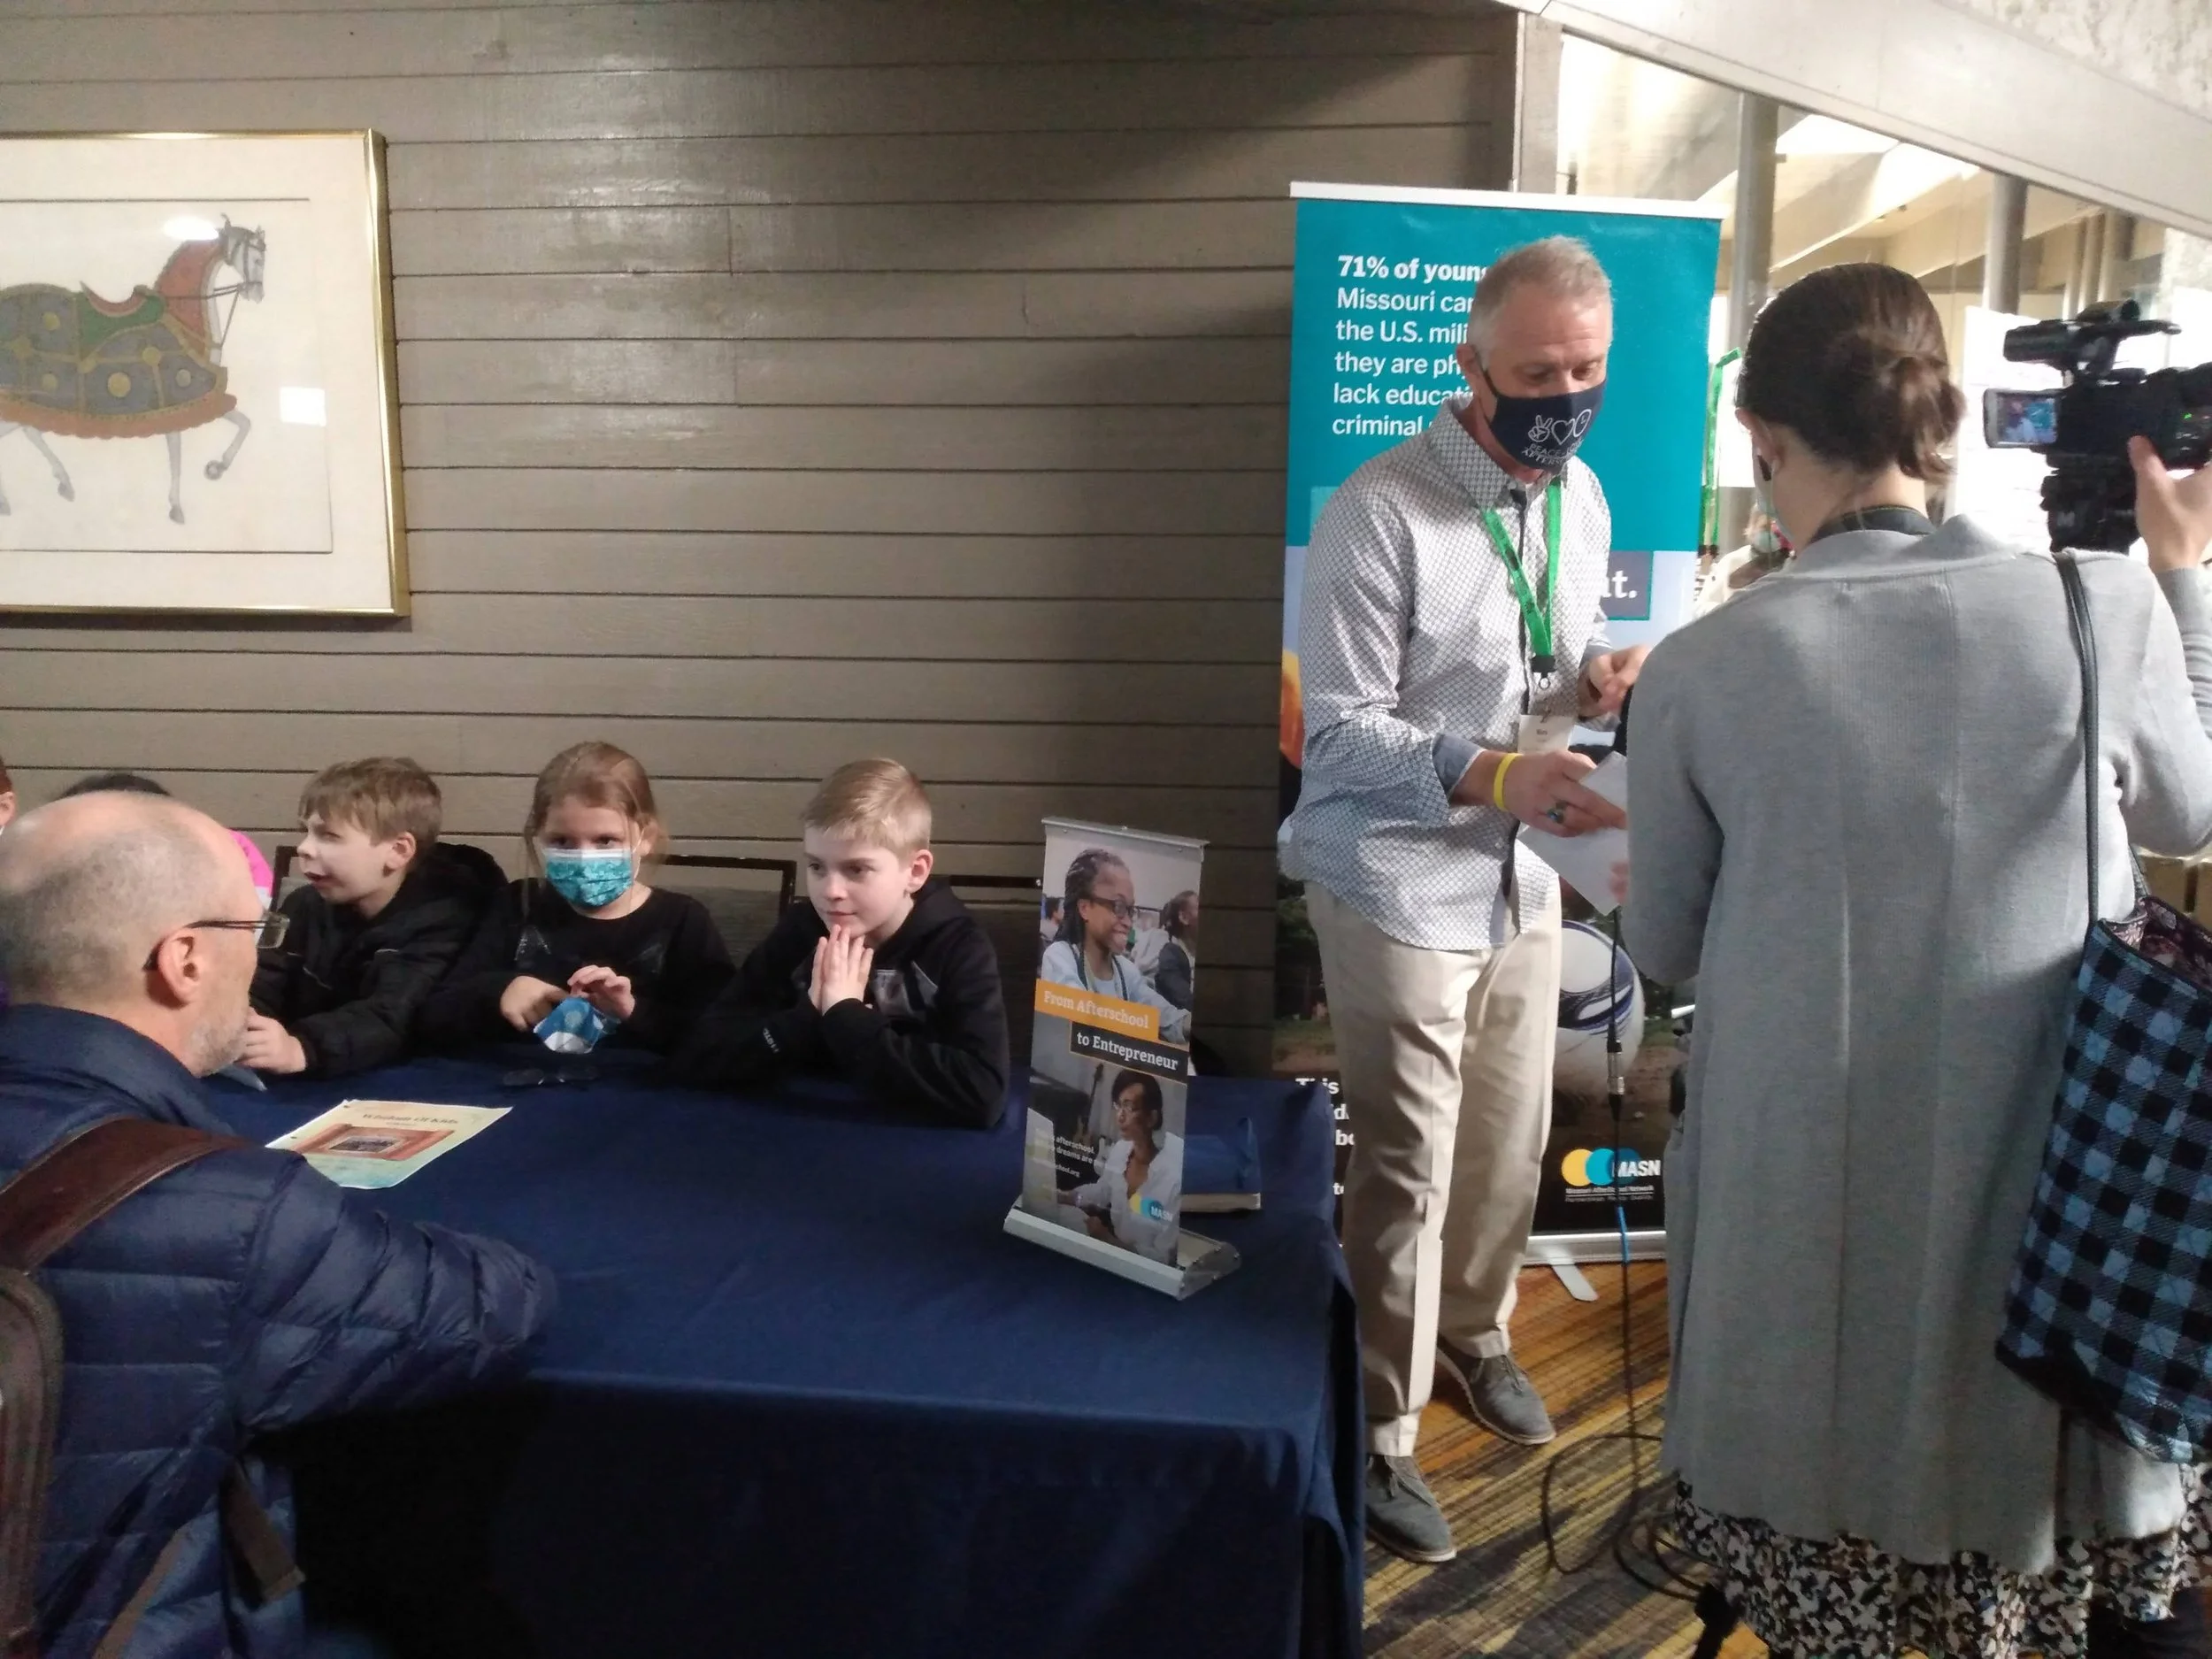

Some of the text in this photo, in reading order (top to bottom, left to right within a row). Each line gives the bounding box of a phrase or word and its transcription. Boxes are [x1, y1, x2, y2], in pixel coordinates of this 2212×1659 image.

[1338, 255, 1390, 279] 71%
[1394, 257, 1420, 280] of
[1337, 287, 1436, 311] Missouri
[1335, 319, 1374, 342] the
[1380, 320, 1424, 343] U.S.
[1334, 350, 1466, 380] they are ph
[1333, 382, 1380, 405] lack
[1332, 414, 1424, 436] criminal
[1043, 990, 1149, 1029] From Afterschool
[1077, 1032, 1179, 1071] to Entrepreneur
[1611, 1160, 1661, 1178] MASN
